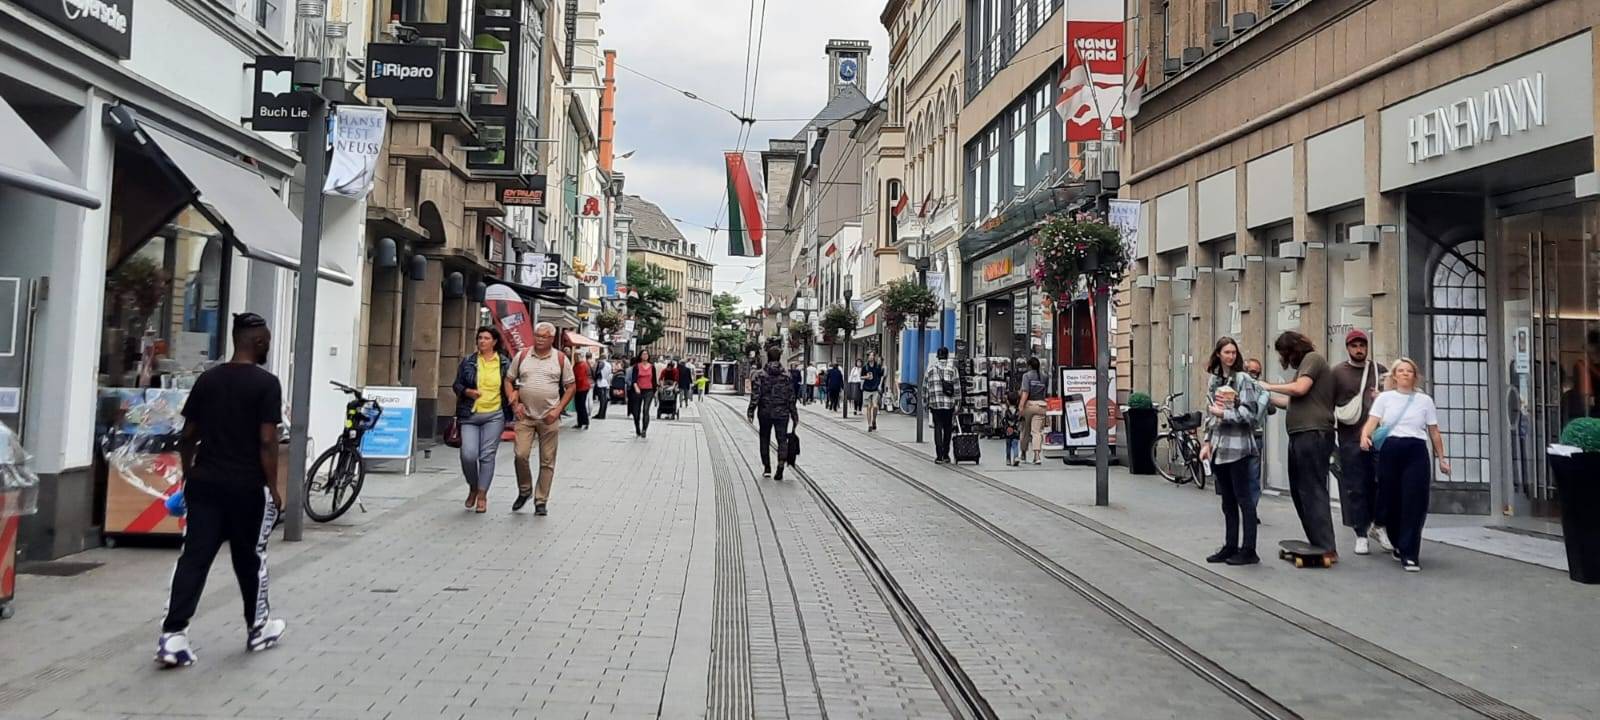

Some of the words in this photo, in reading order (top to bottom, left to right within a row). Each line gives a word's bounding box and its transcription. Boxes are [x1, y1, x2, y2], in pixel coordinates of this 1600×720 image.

[383, 62, 434, 80] iRiparo
[260, 106, 288, 117] Buch
[339, 114, 383, 128] HANSE
[336, 141, 380, 155] NEUSS
